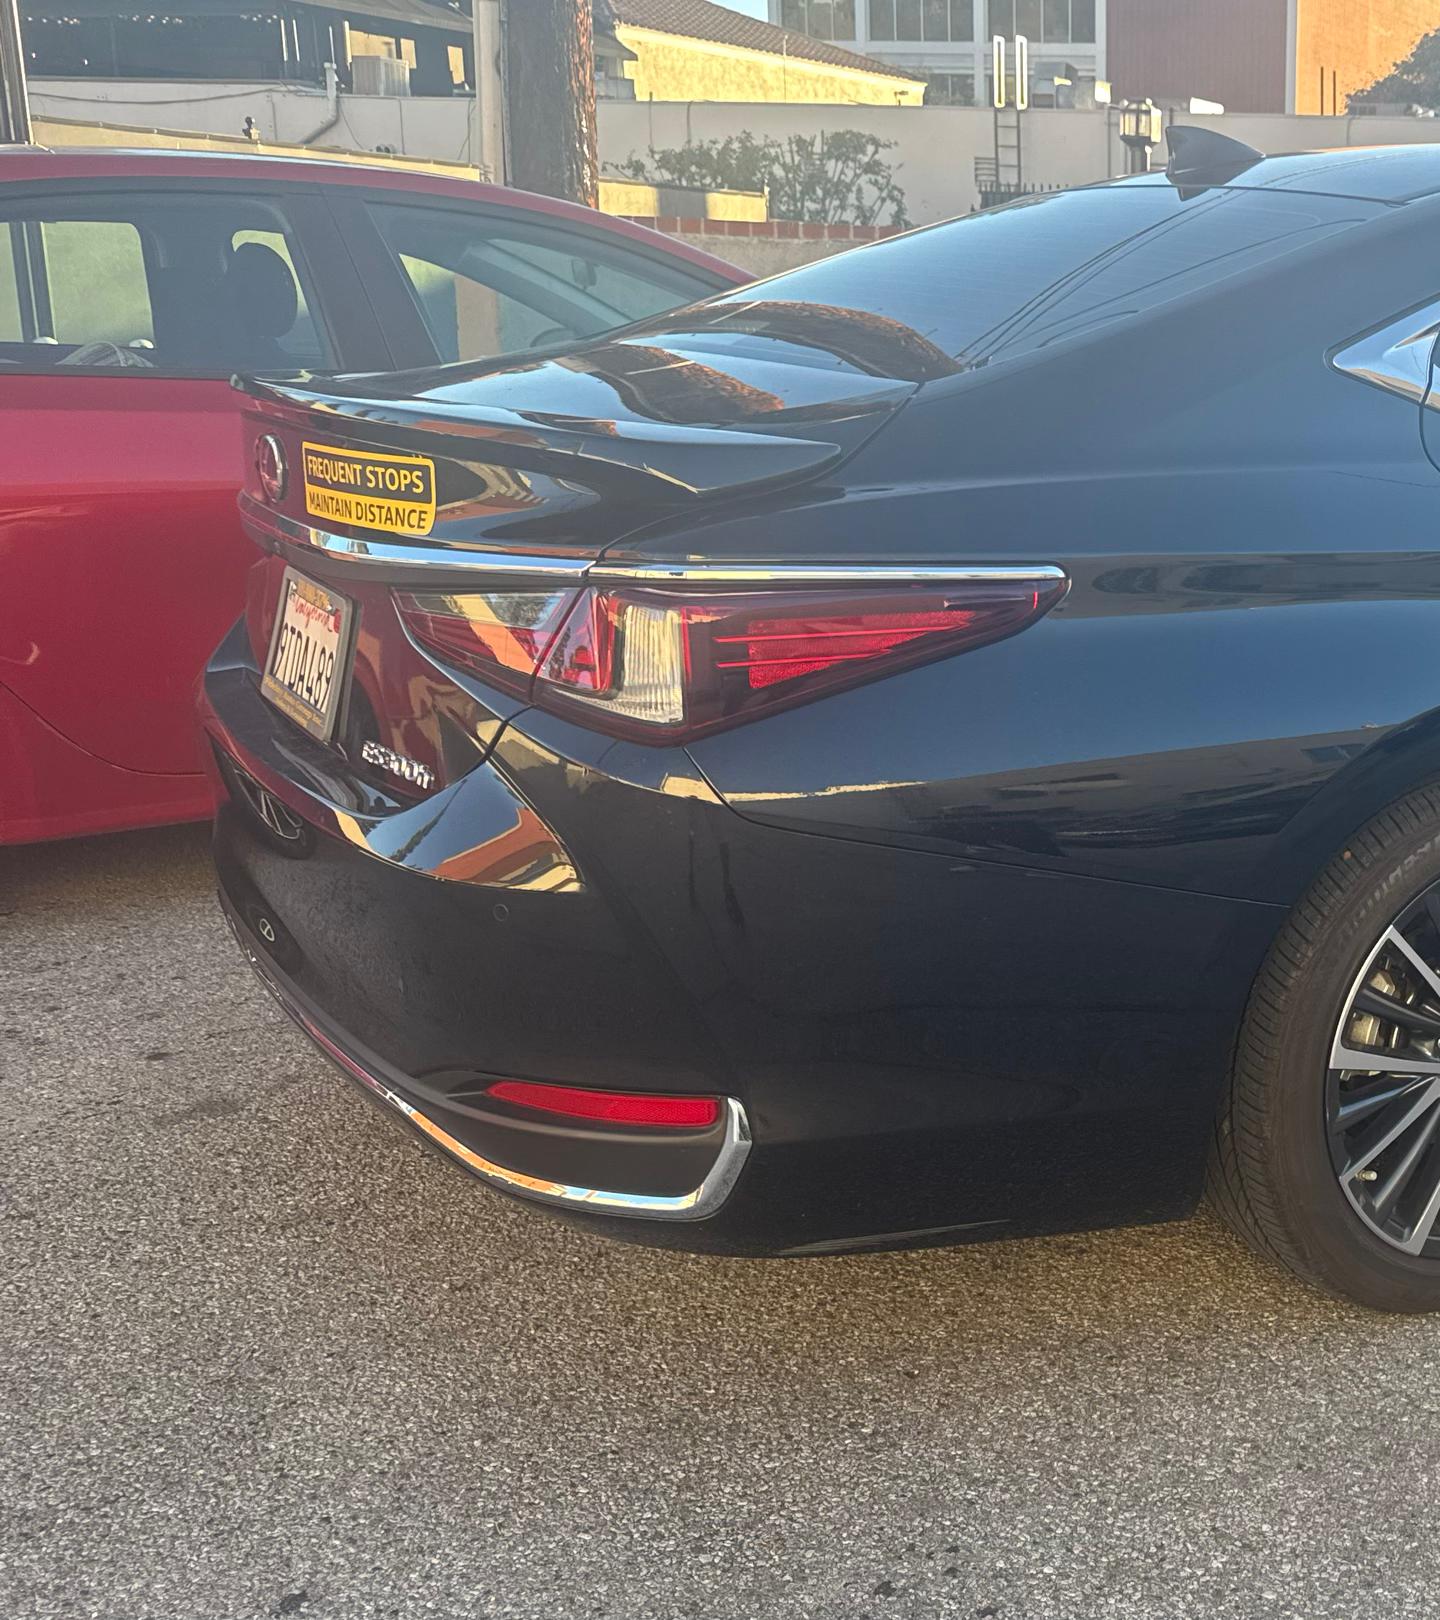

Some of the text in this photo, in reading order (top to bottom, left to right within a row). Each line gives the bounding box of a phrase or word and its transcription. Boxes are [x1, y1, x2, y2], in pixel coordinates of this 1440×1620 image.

[306, 455, 425, 494] FREQUENT STOPS
[309, 491, 428, 530] MAINTAIN DISTANCE
[273, 622, 335, 711] 9TDA489
